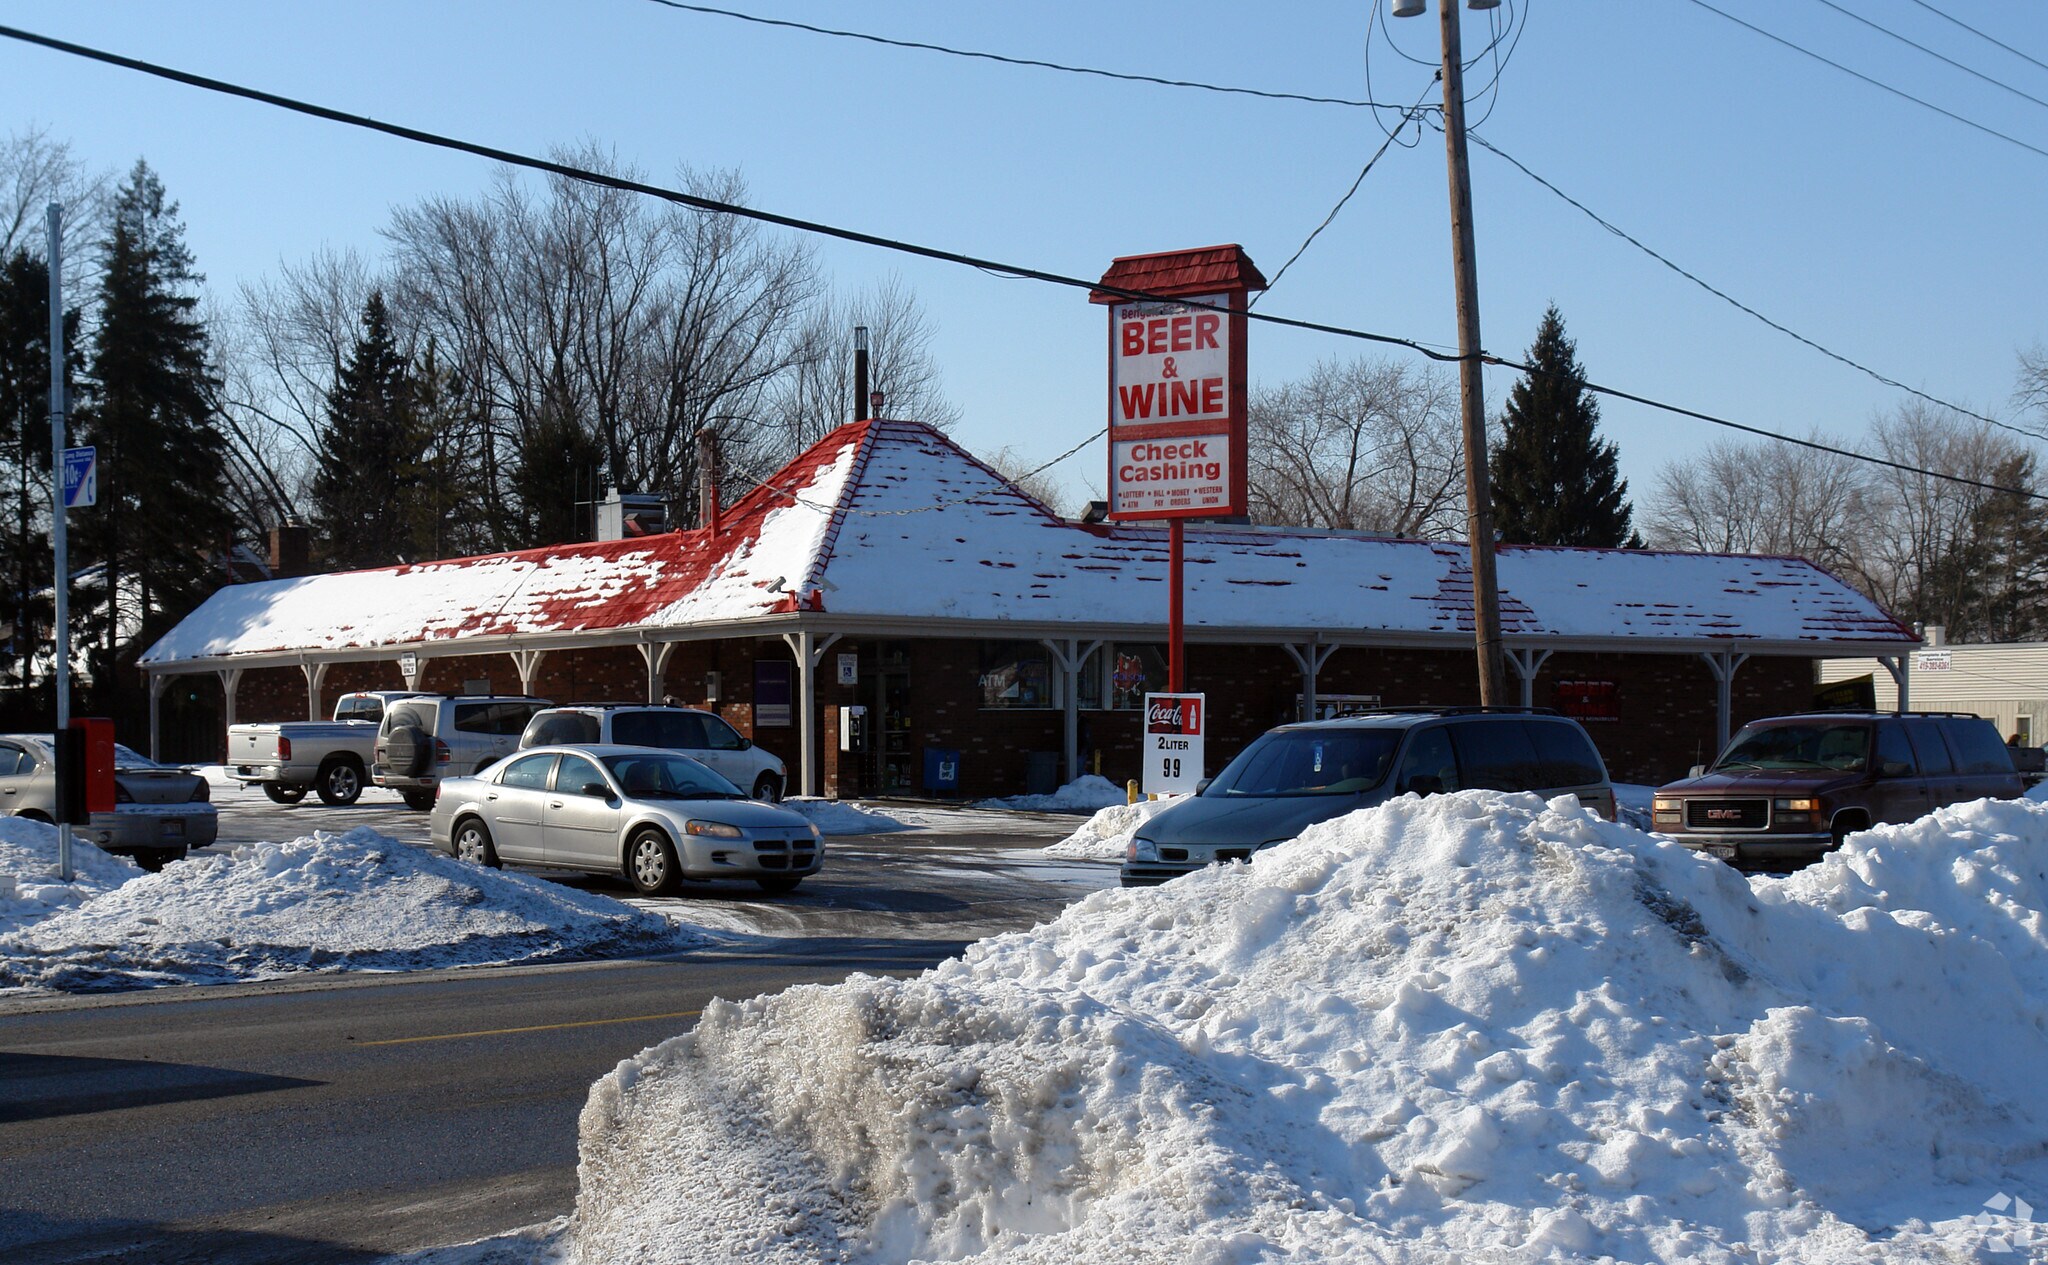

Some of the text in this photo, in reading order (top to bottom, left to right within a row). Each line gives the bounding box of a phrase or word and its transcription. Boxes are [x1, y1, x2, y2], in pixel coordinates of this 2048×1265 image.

[1123, 314, 1220, 357] BEER
[1162, 356, 1178, 379] &
[1119, 377, 1223, 419] WINE
[1131, 440, 1208, 462] Check
[1119, 461, 1220, 483] Cashing
[1122, 486, 1223, 499] LOTTERY BILL MONEY WESTERN
[1154, 499, 1164, 507] PAY
[1169, 498, 1191, 506] ORDERS
[1202, 496, 1219, 505] UNION
[978, 674, 1006, 689] ATM
[1163, 758, 1180, 778] 99
[1708, 809, 1741, 819] GMC
